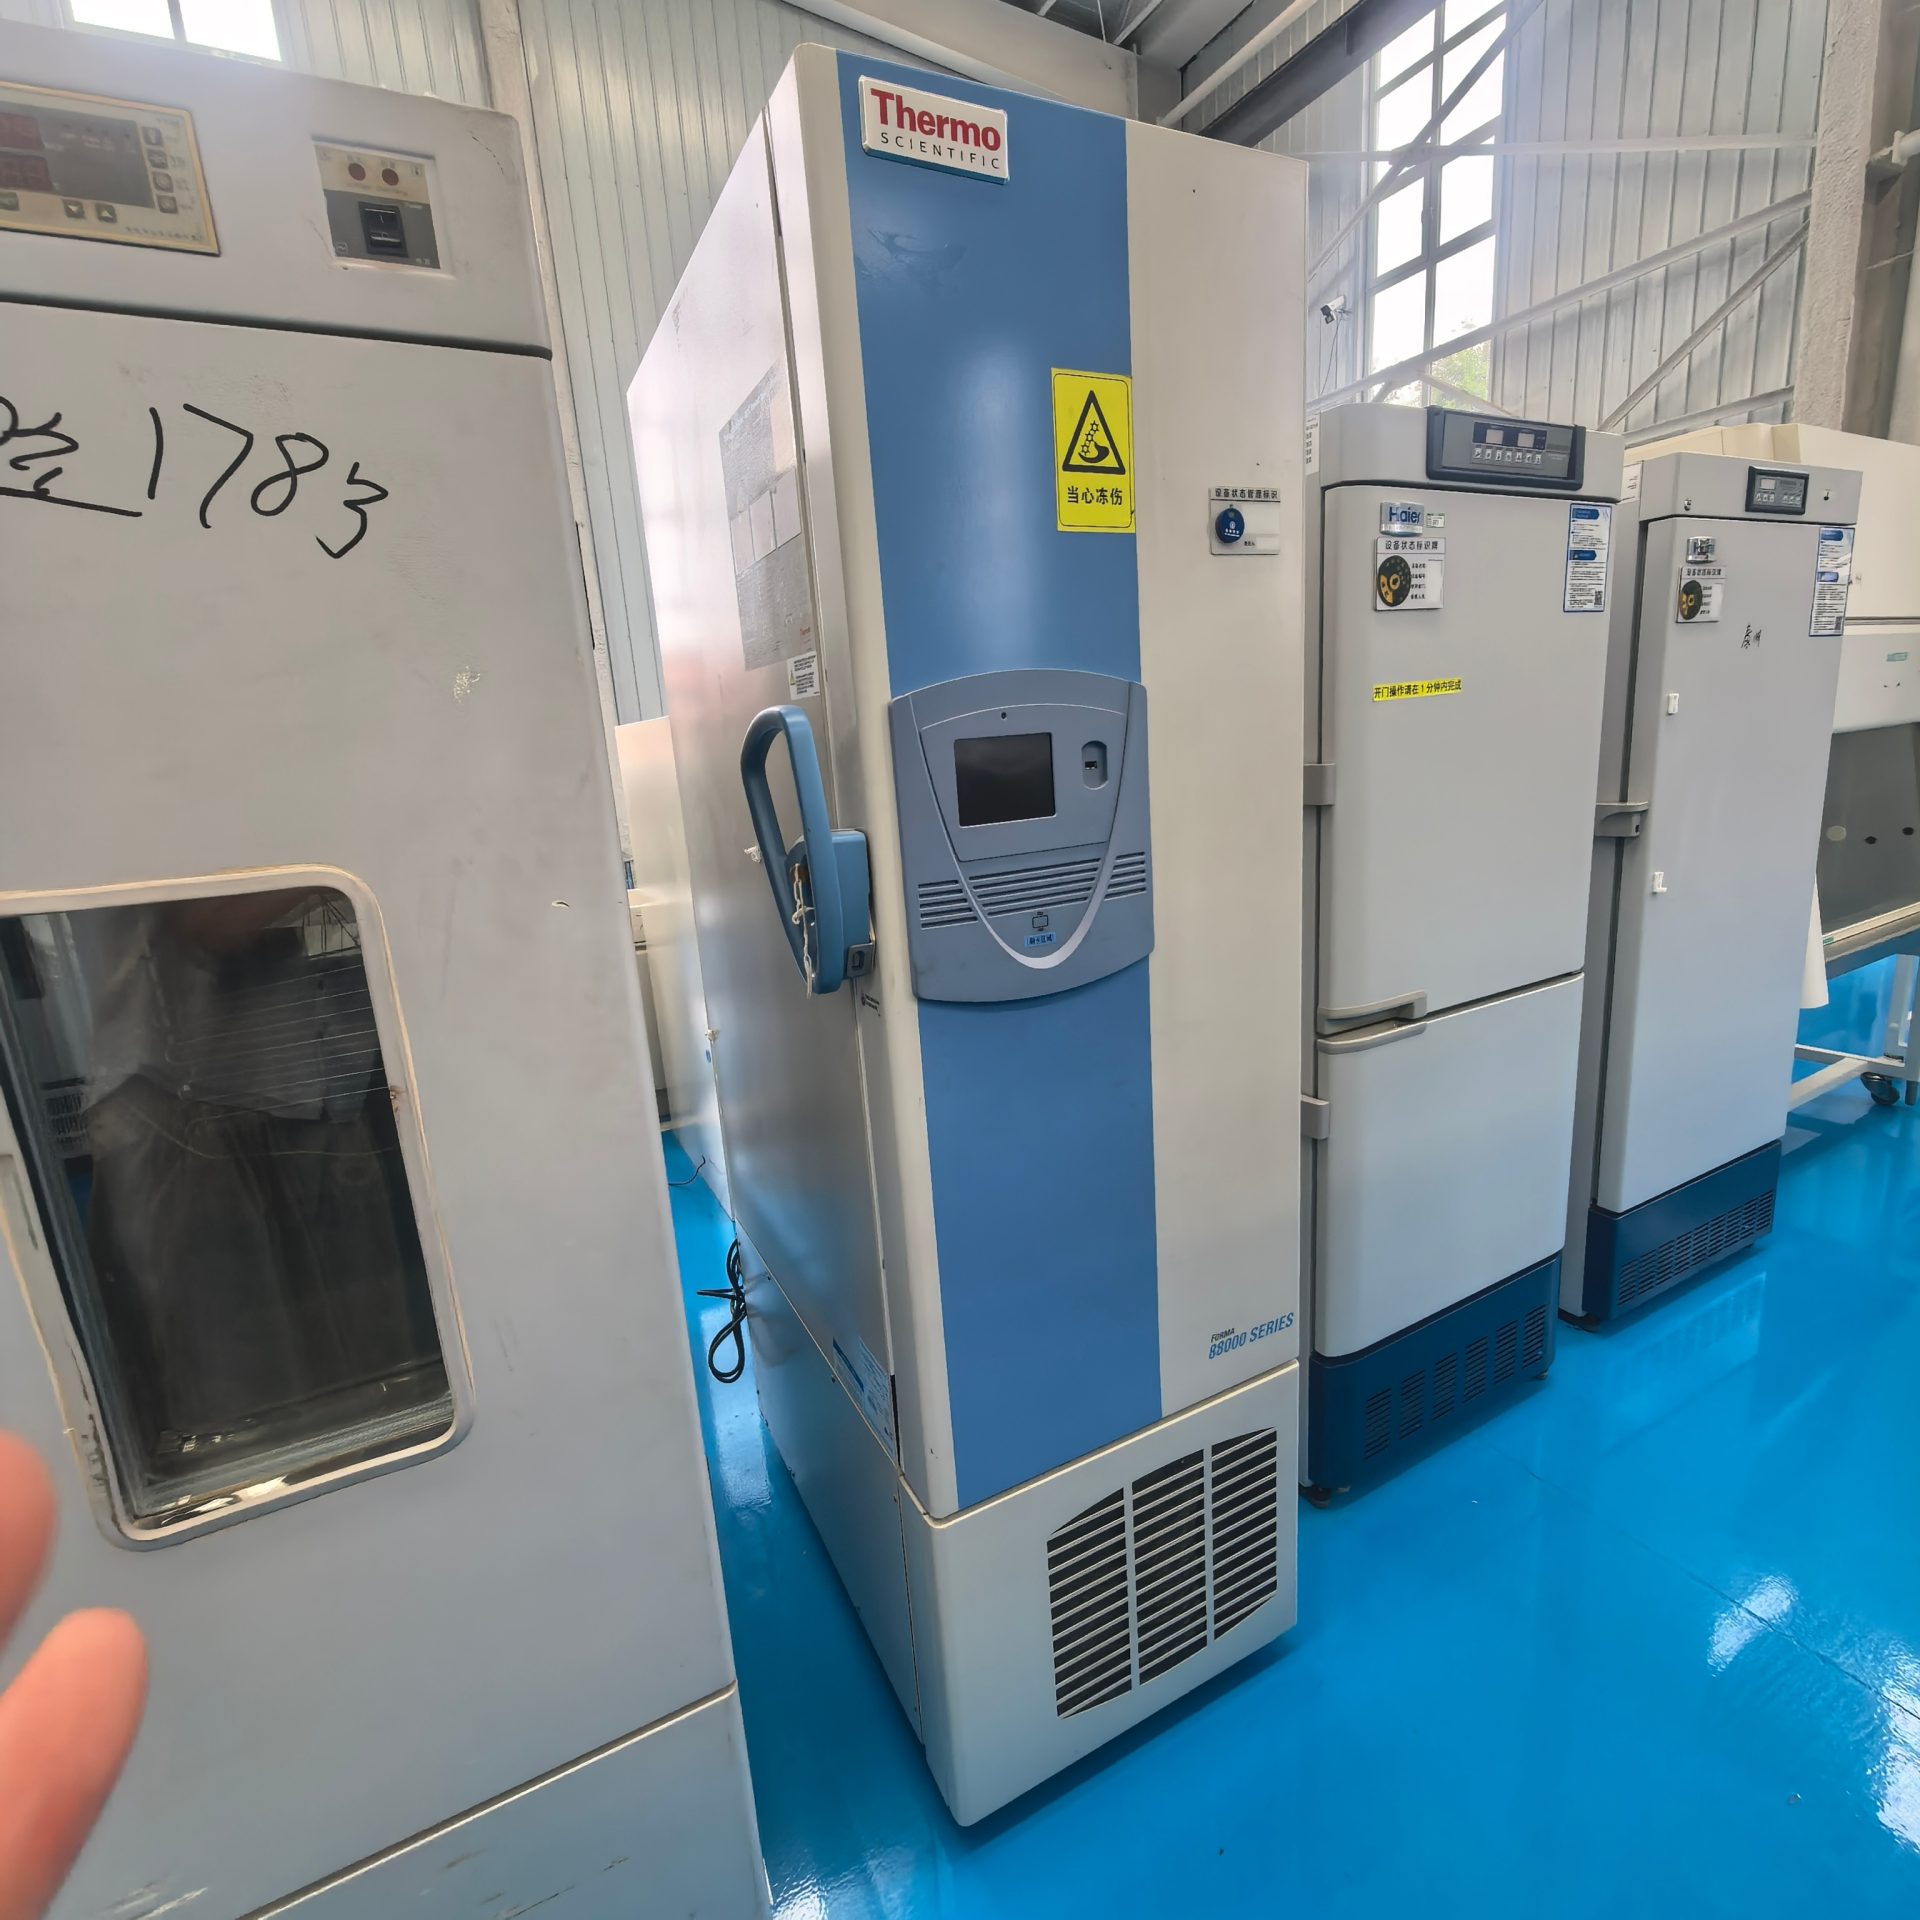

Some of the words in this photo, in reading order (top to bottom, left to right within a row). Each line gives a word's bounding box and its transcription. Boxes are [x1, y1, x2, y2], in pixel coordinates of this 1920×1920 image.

[870, 88, 1001, 151] Thermo
[880, 132, 1001, 169] SCIENTIFIC
[1067, 485, 1123, 506] 当心冻伤
[1389, 506, 1421, 523] Haier
[1208, 1332, 1247, 1360] 88000
[1249, 1312, 1294, 1342] SERIES
[1211, 1328, 1235, 1343] FORMA
